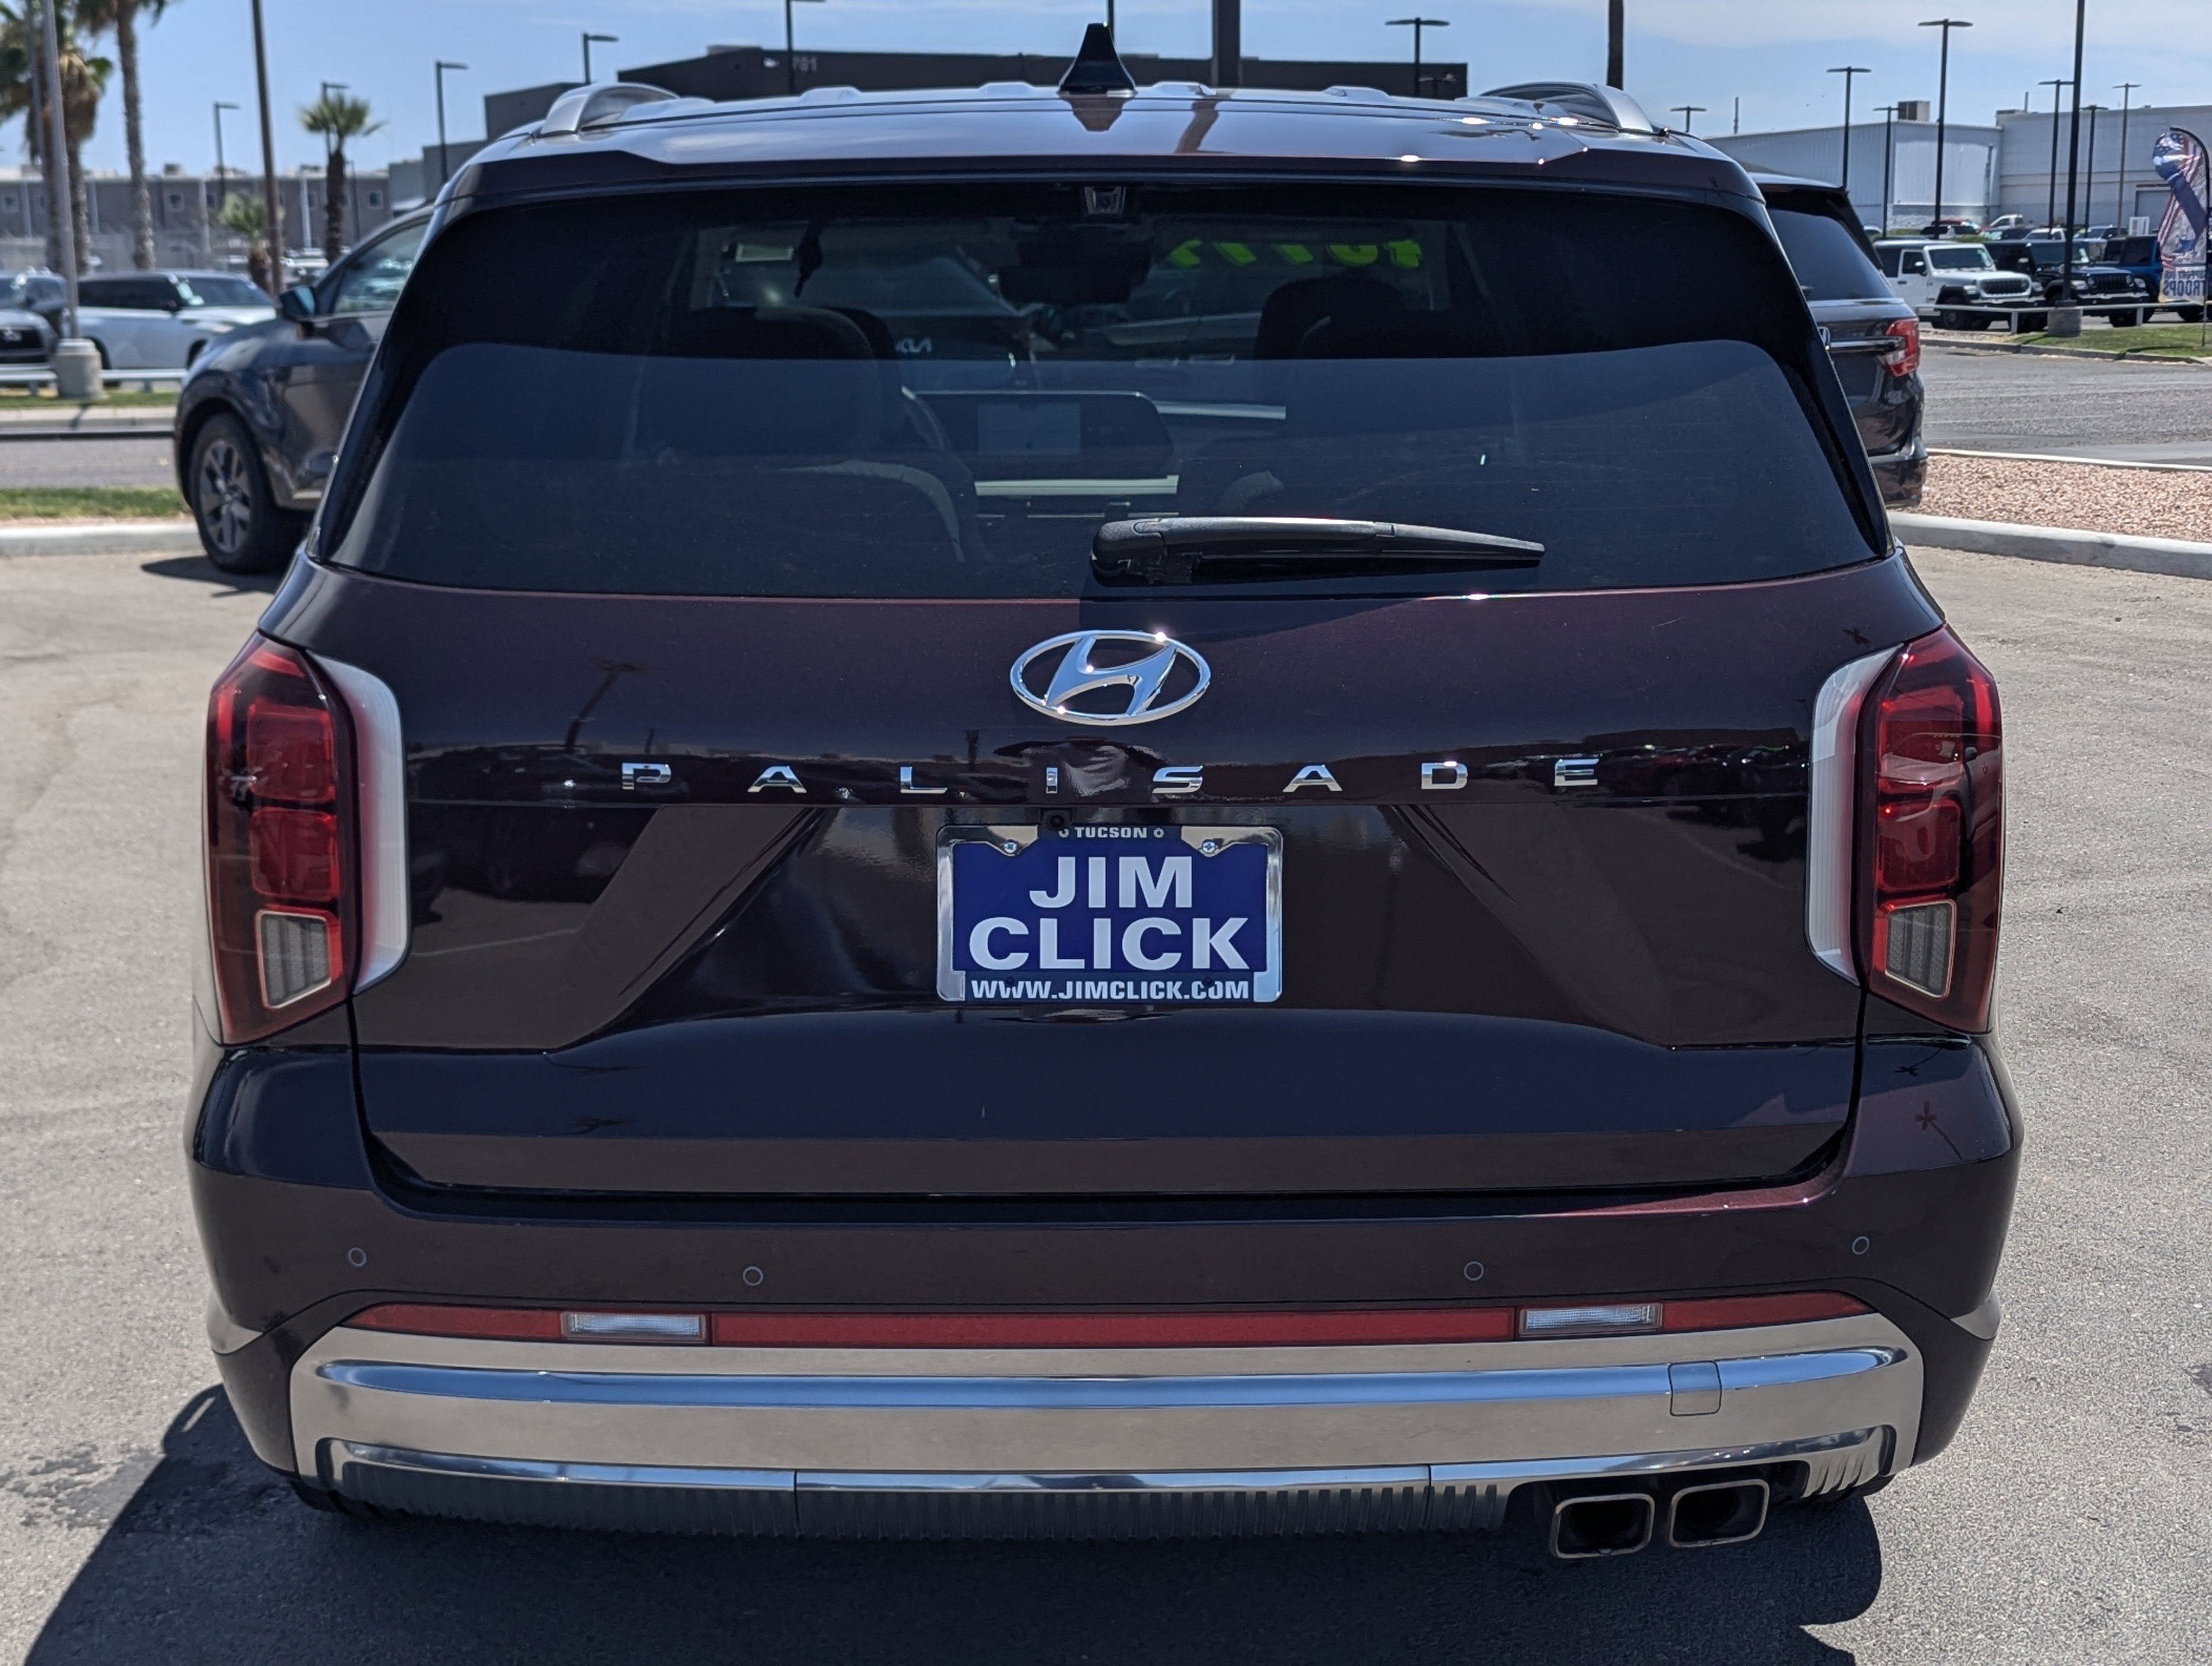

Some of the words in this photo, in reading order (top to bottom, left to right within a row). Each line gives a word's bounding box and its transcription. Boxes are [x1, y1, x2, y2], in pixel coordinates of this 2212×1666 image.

[621, 759, 1601, 794] PALISADE
[1075, 826, 1148, 838] TUCSON
[1029, 856, 1193, 908] JIM
[969, 917, 1250, 970] CLICK
[971, 979, 1249, 1001] WWW.JIMCLICK.COM
